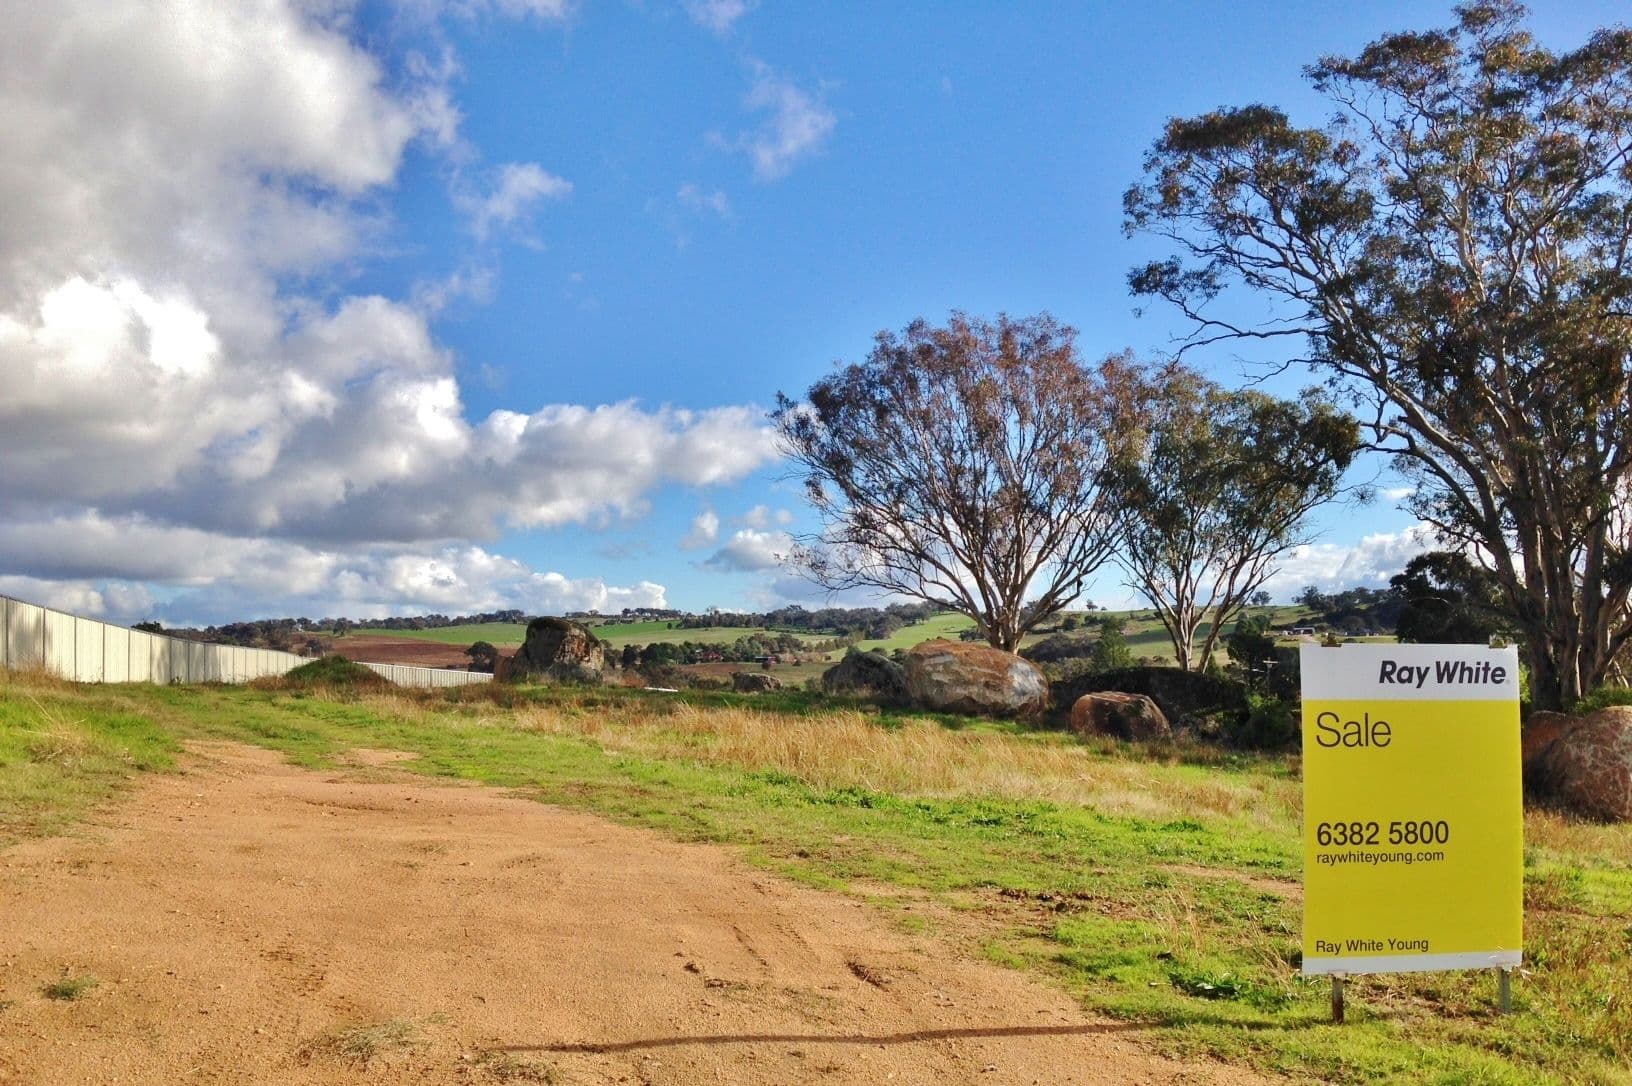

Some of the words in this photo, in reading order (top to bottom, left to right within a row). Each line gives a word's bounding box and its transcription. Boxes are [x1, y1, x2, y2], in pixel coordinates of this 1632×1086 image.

[1379, 660, 1430, 688] Ray
[1435, 660, 1506, 684] White
[1316, 711, 1391, 747] Sale
[1316, 822, 1380, 846] 6382
[1388, 820, 1449, 845] 5800
[1316, 850, 1444, 866] raywhiteyoung.com
[1316, 940, 1341, 955] Ray
[1346, 939, 1383, 951] White
[1388, 938, 1429, 952] Young
